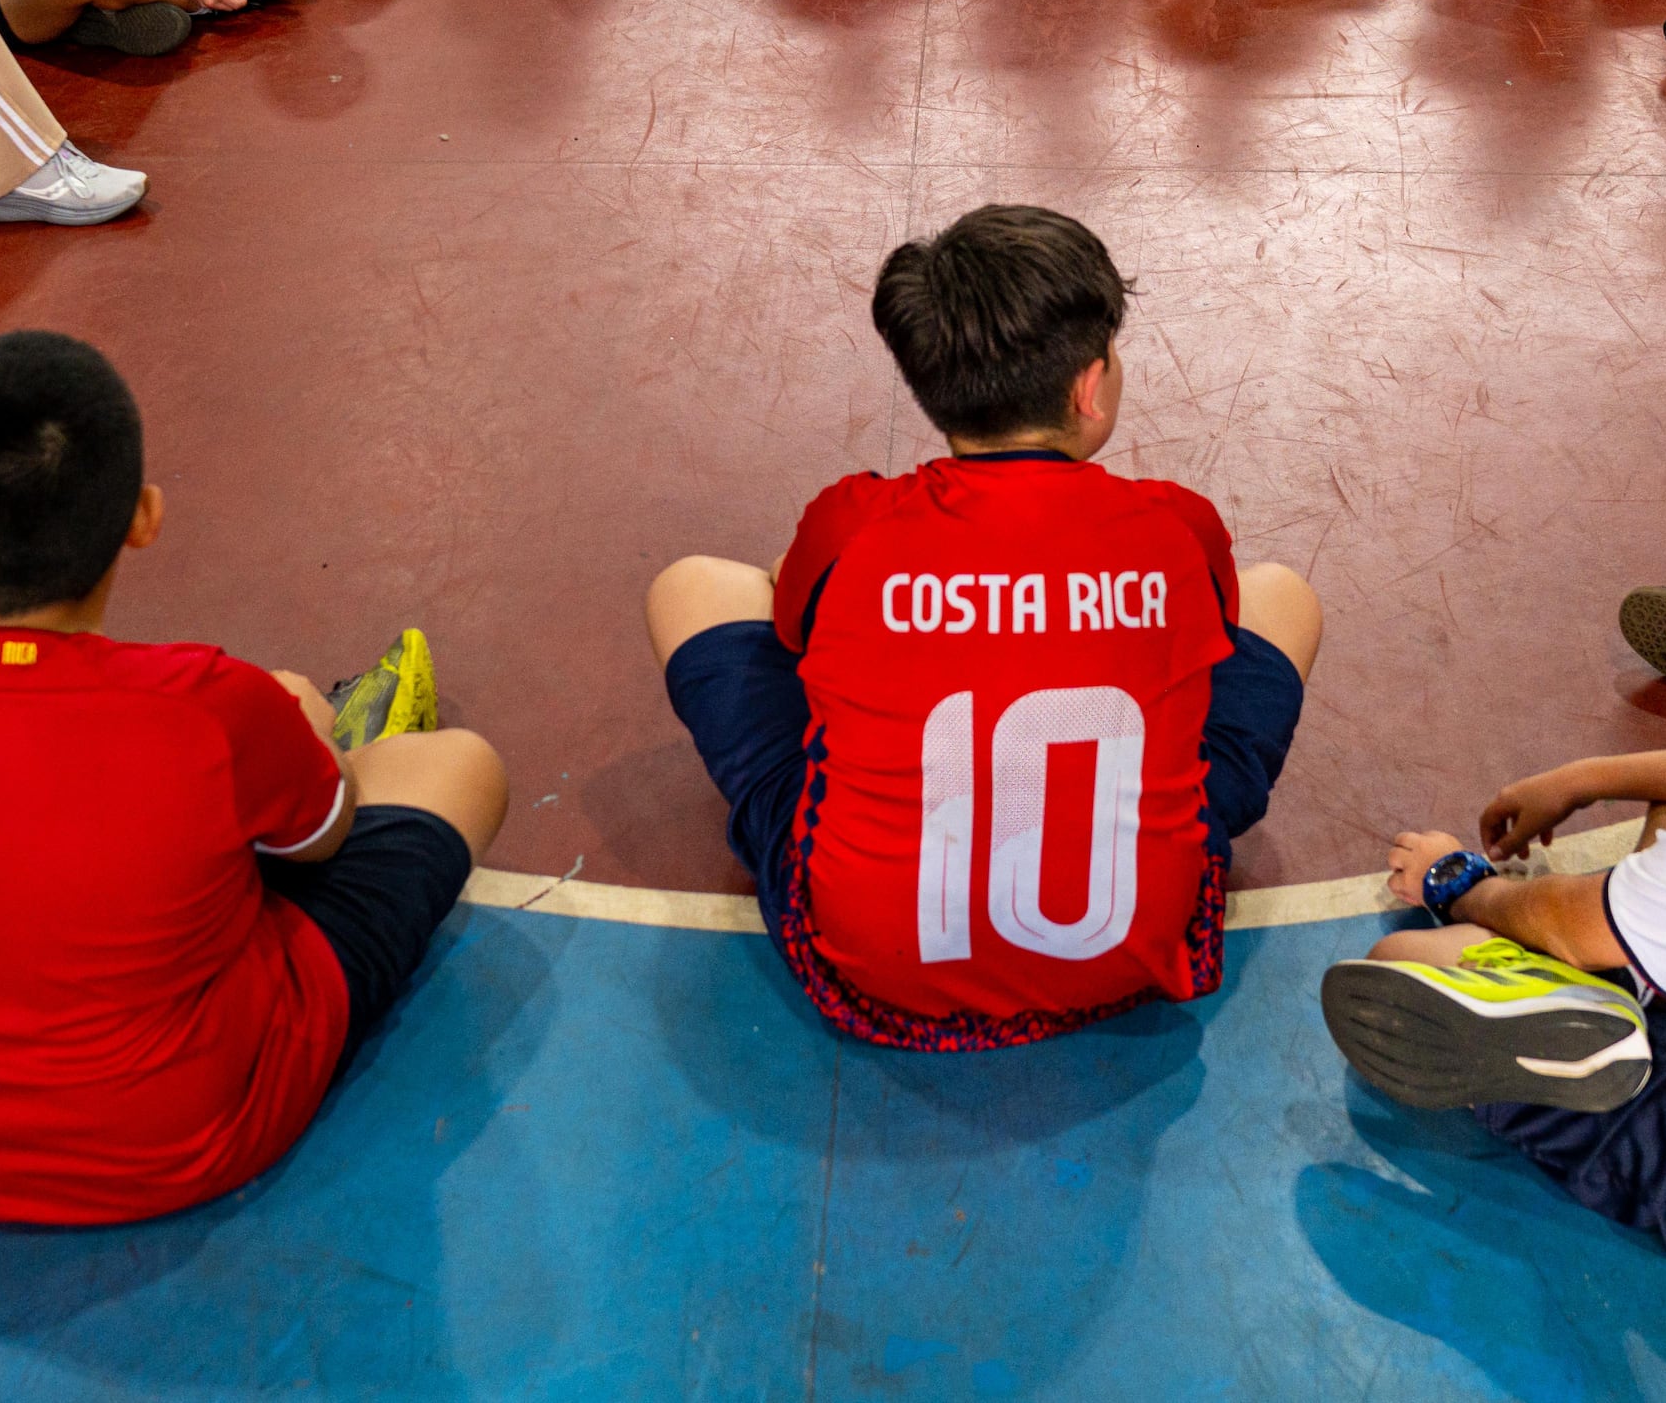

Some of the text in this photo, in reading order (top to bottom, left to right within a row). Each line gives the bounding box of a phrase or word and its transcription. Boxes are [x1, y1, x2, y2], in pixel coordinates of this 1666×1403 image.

[882, 571, 1168, 634] COSTA RICA
[917, 685, 1146, 964] 10
